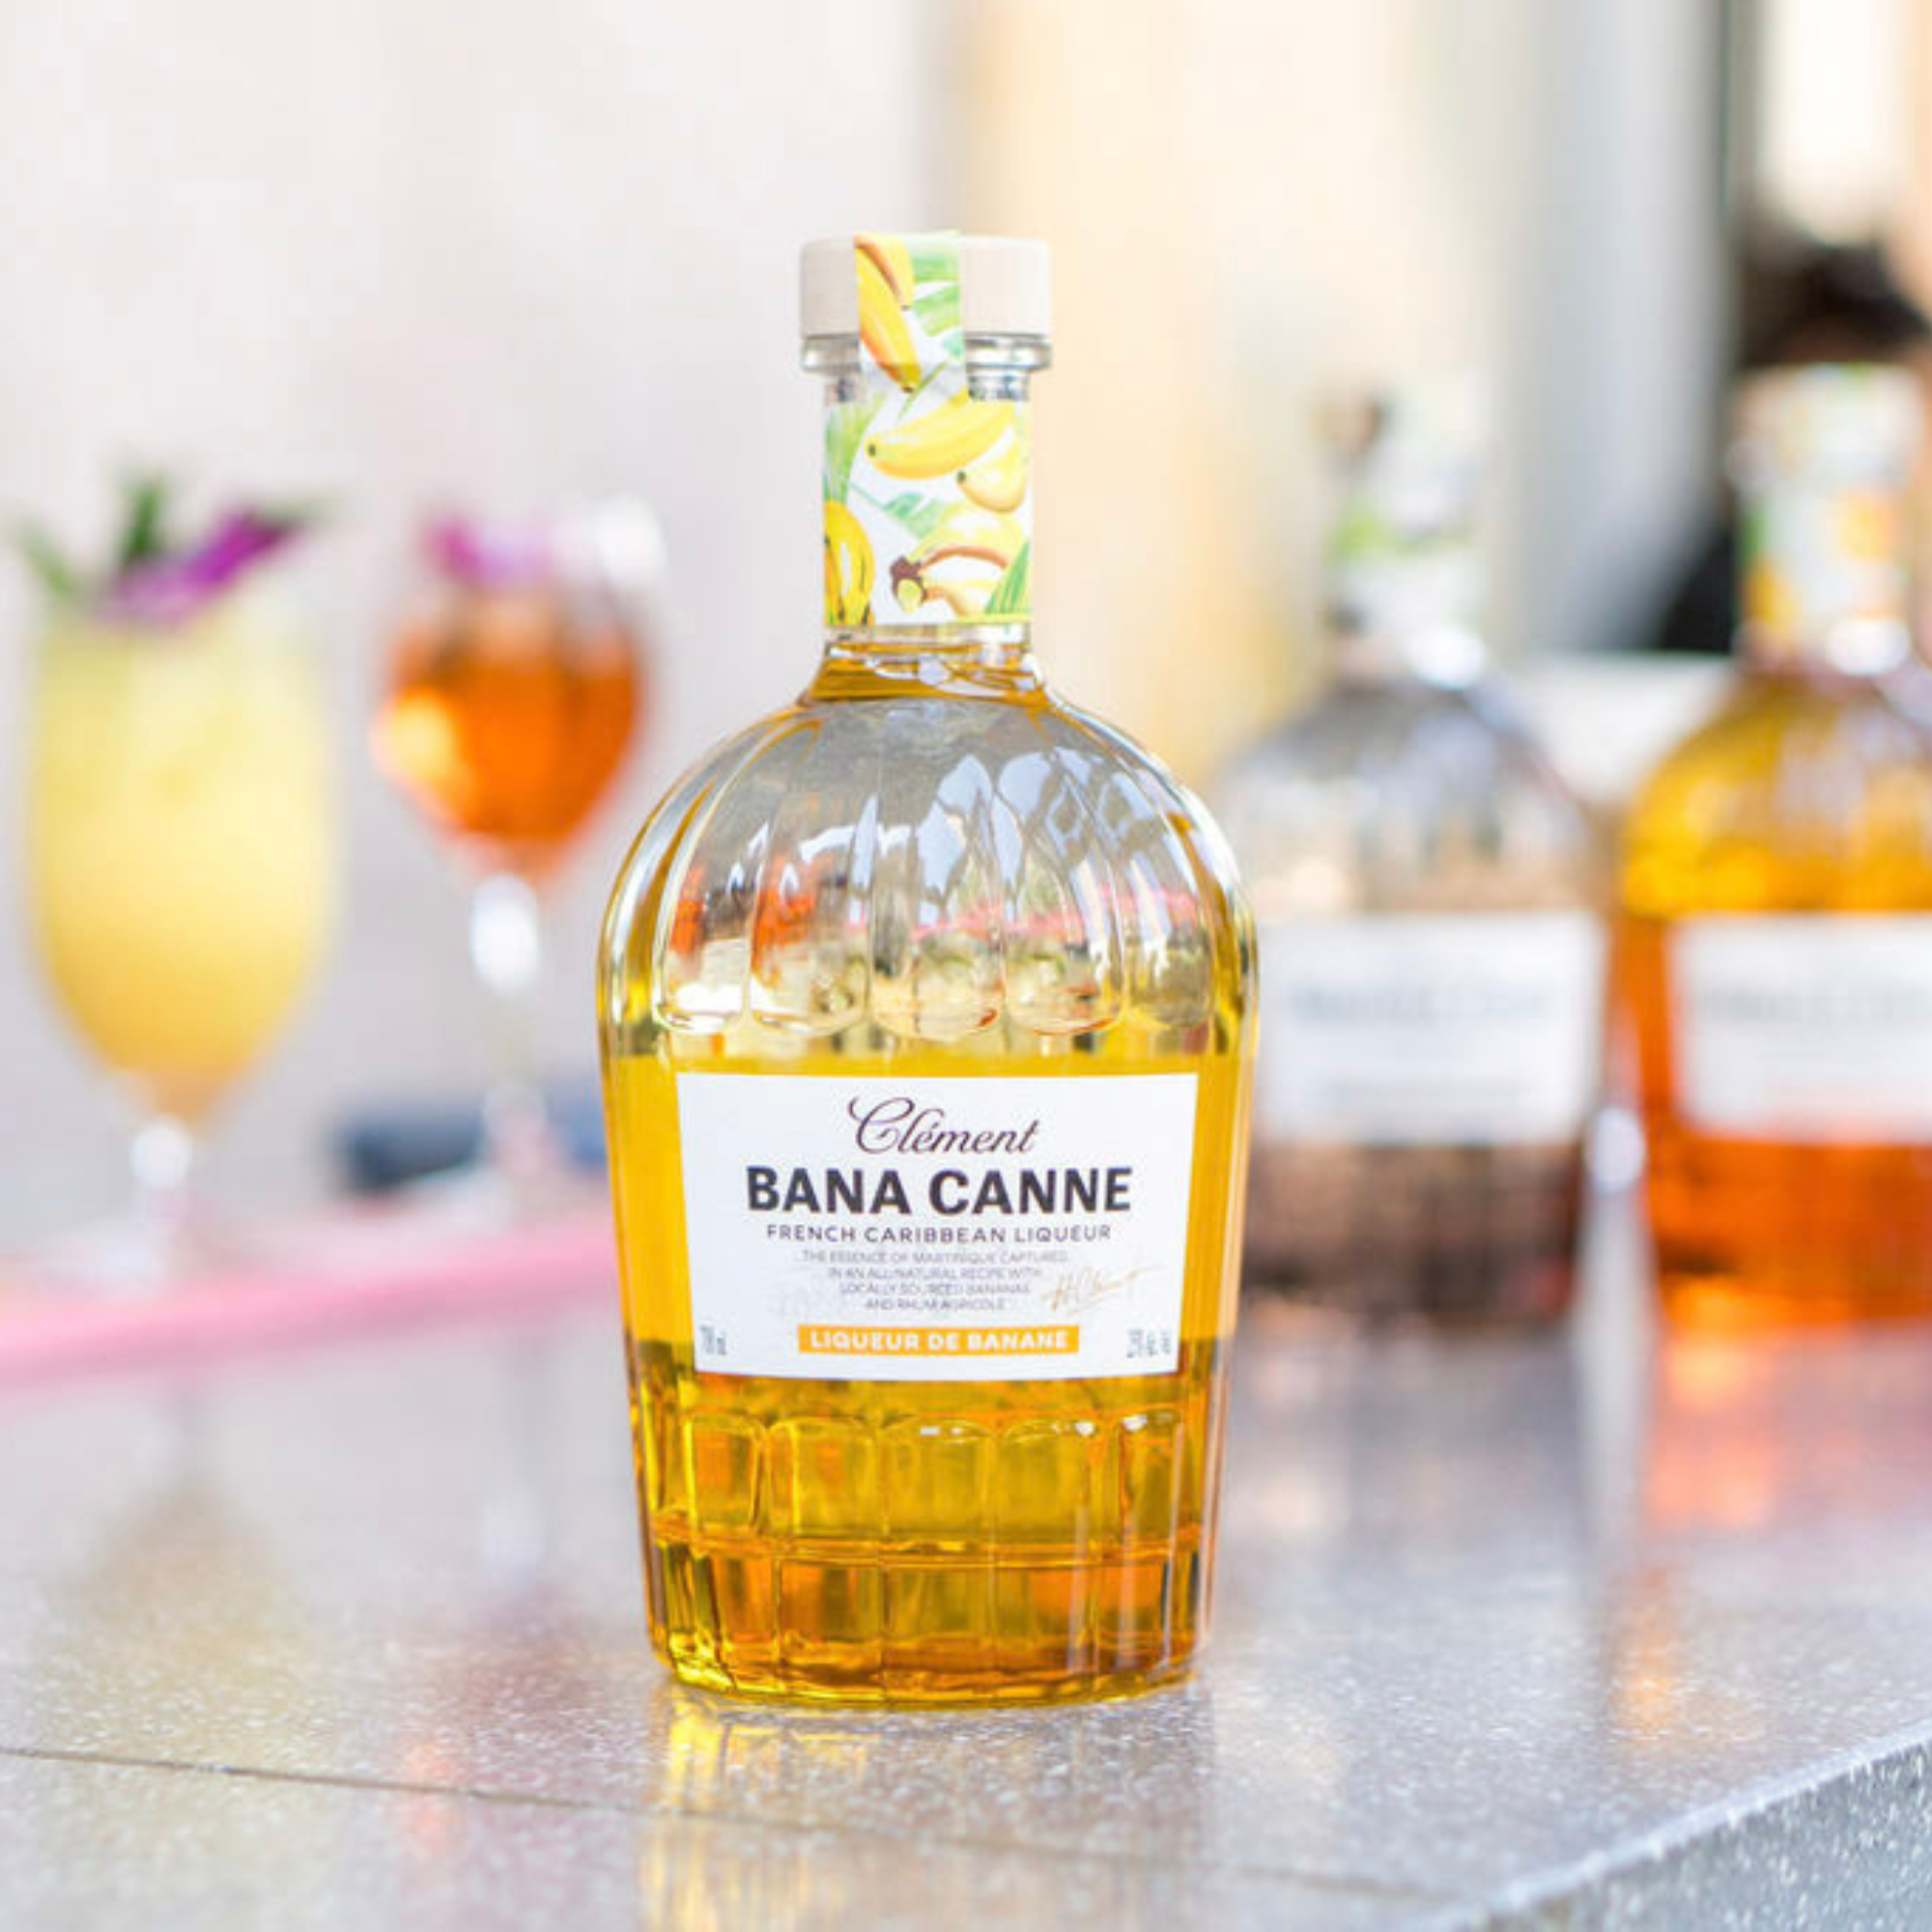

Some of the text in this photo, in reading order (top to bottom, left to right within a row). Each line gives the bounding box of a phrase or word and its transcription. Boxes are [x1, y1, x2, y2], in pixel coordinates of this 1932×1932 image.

[848, 1096, 1040, 1154] Clément
[746, 1166, 1132, 1214] BANA CANNE
[767, 1224, 1111, 1243] FRENCH CARIBBEAN LIQUEUR
[803, 1250, 826, 1263] THE
[845, 1266, 865, 1279] AN
[810, 1330, 1068, 1351] LIQUEUR DE BANANE
